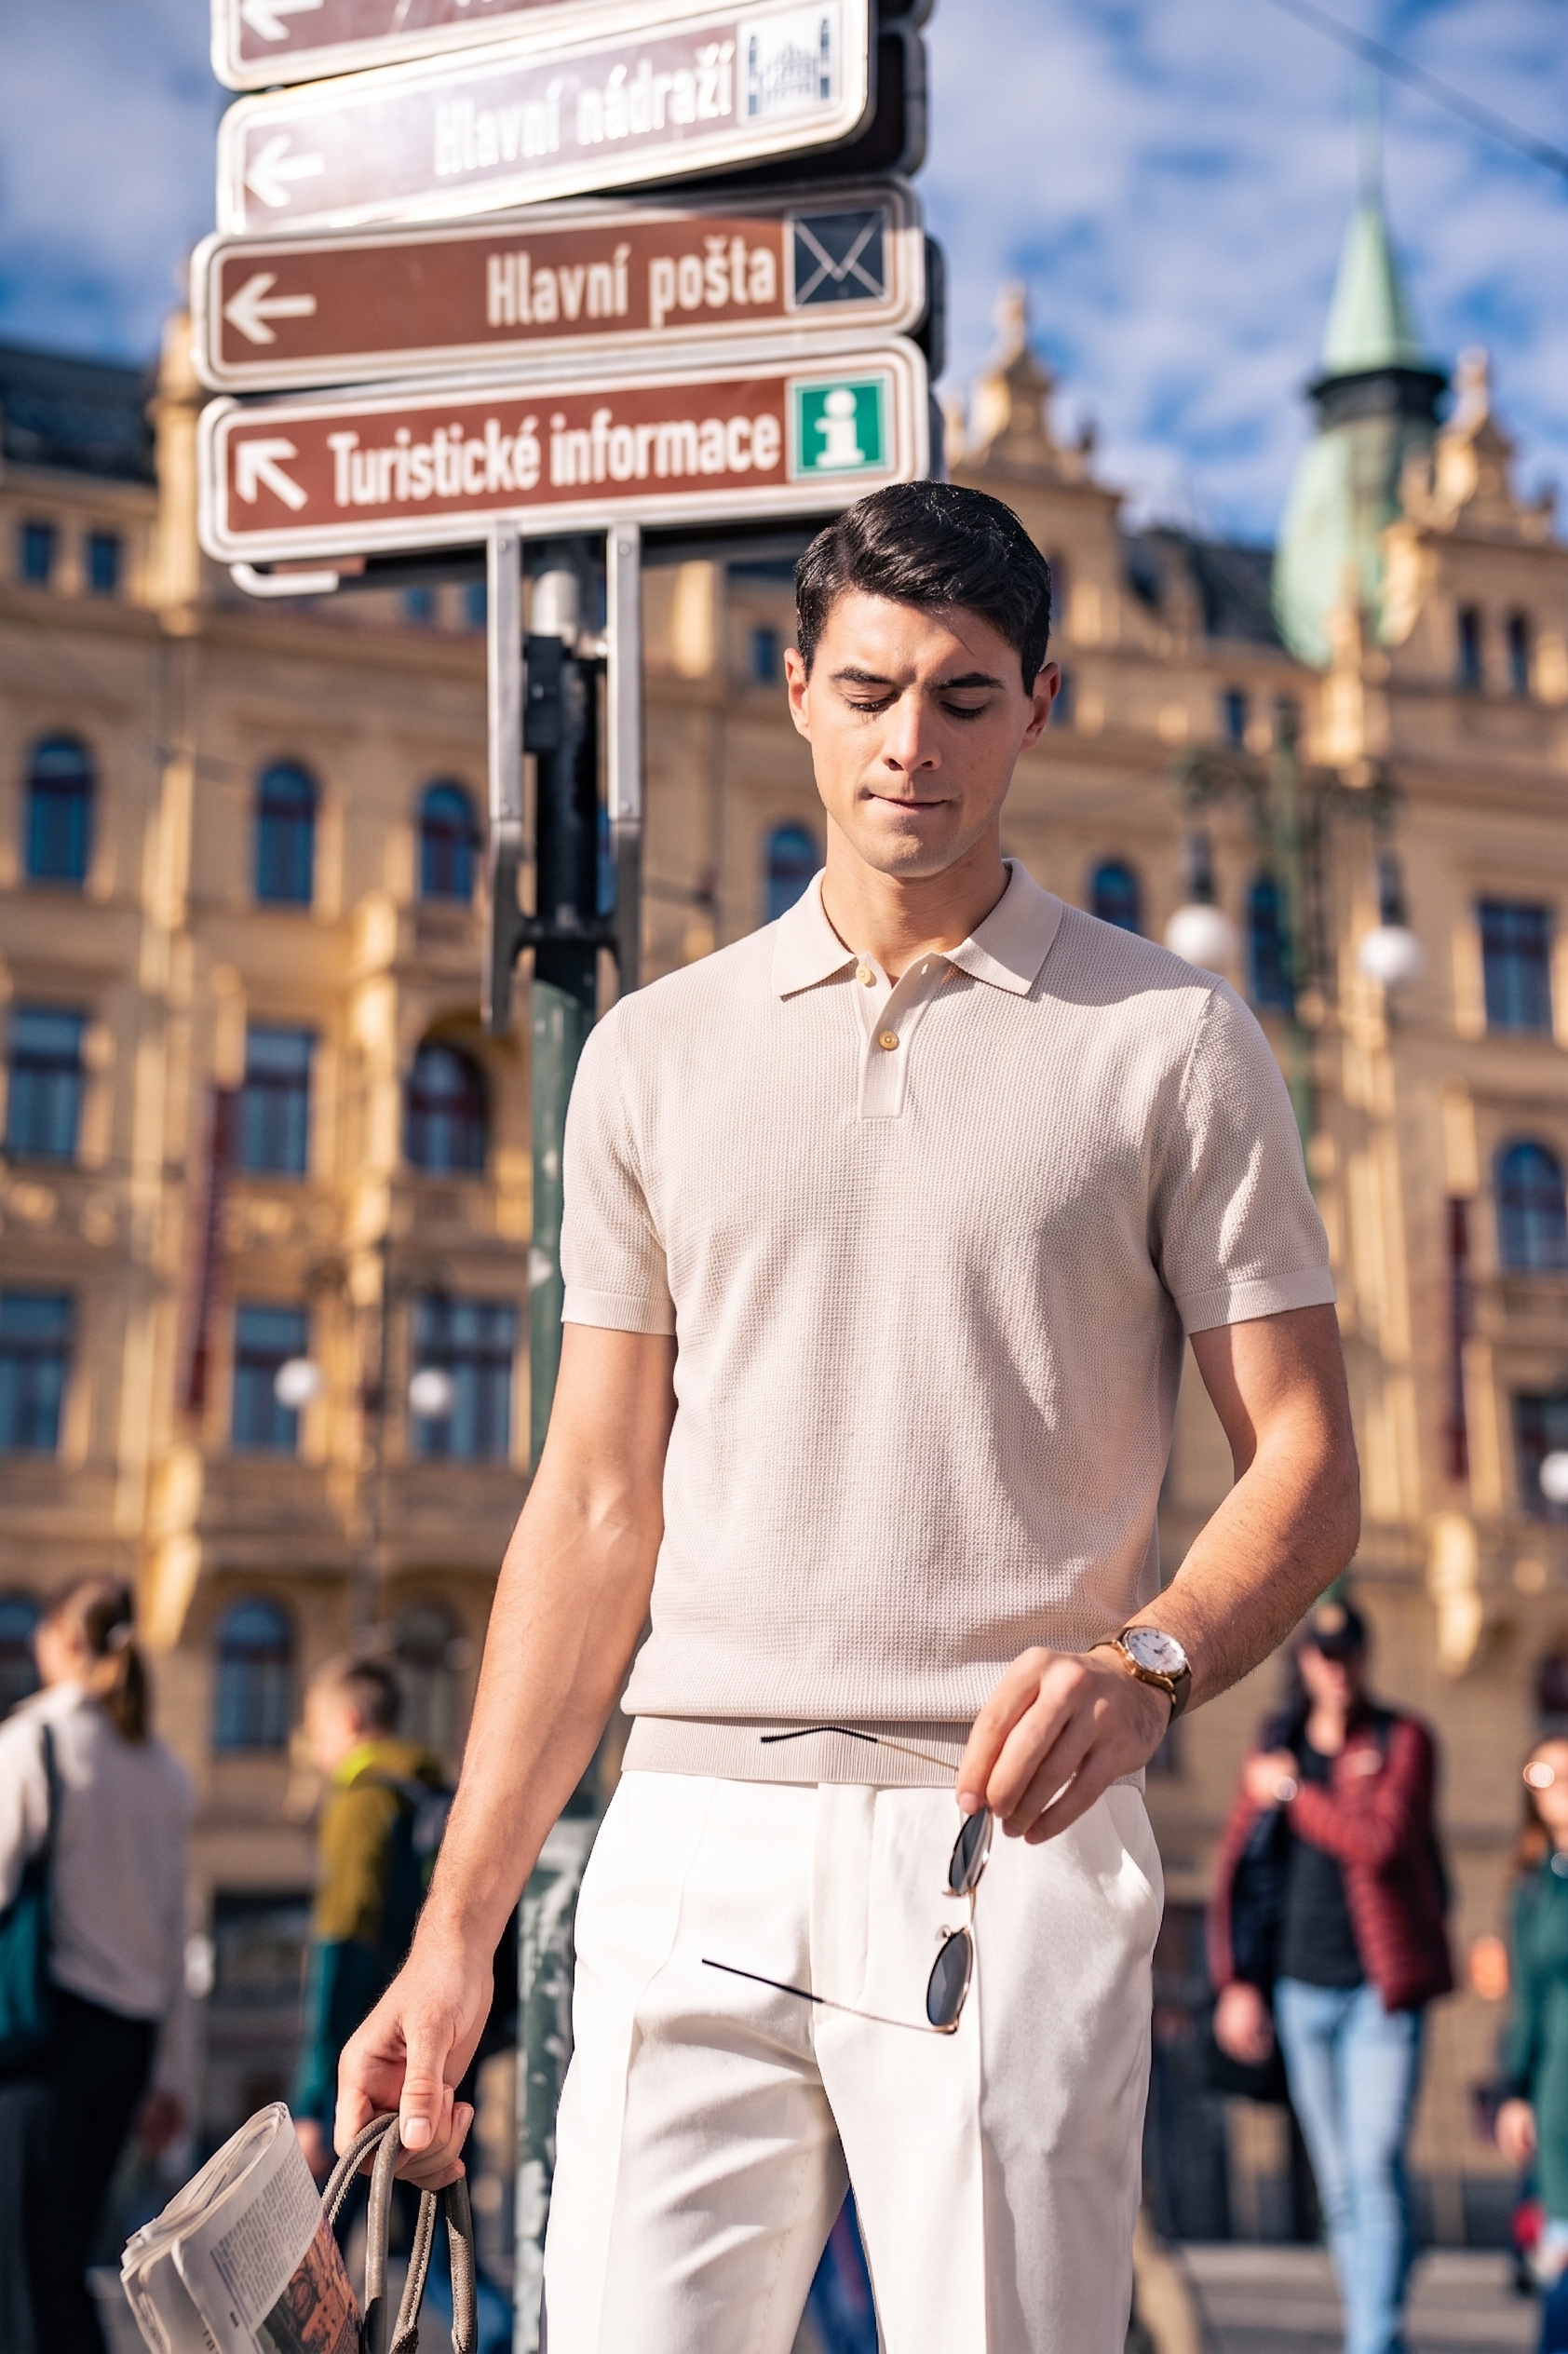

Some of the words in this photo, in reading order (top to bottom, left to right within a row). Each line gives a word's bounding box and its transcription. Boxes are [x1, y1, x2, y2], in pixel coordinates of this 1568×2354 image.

[434, 74, 563, 176] Hlavní
[576, 40, 735, 146] nádraží
[487, 242, 630, 328] Hlavní
[648, 233, 778, 330] pošta
[327, 414, 541, 508] Turistické
[549, 407, 781, 487] informace
